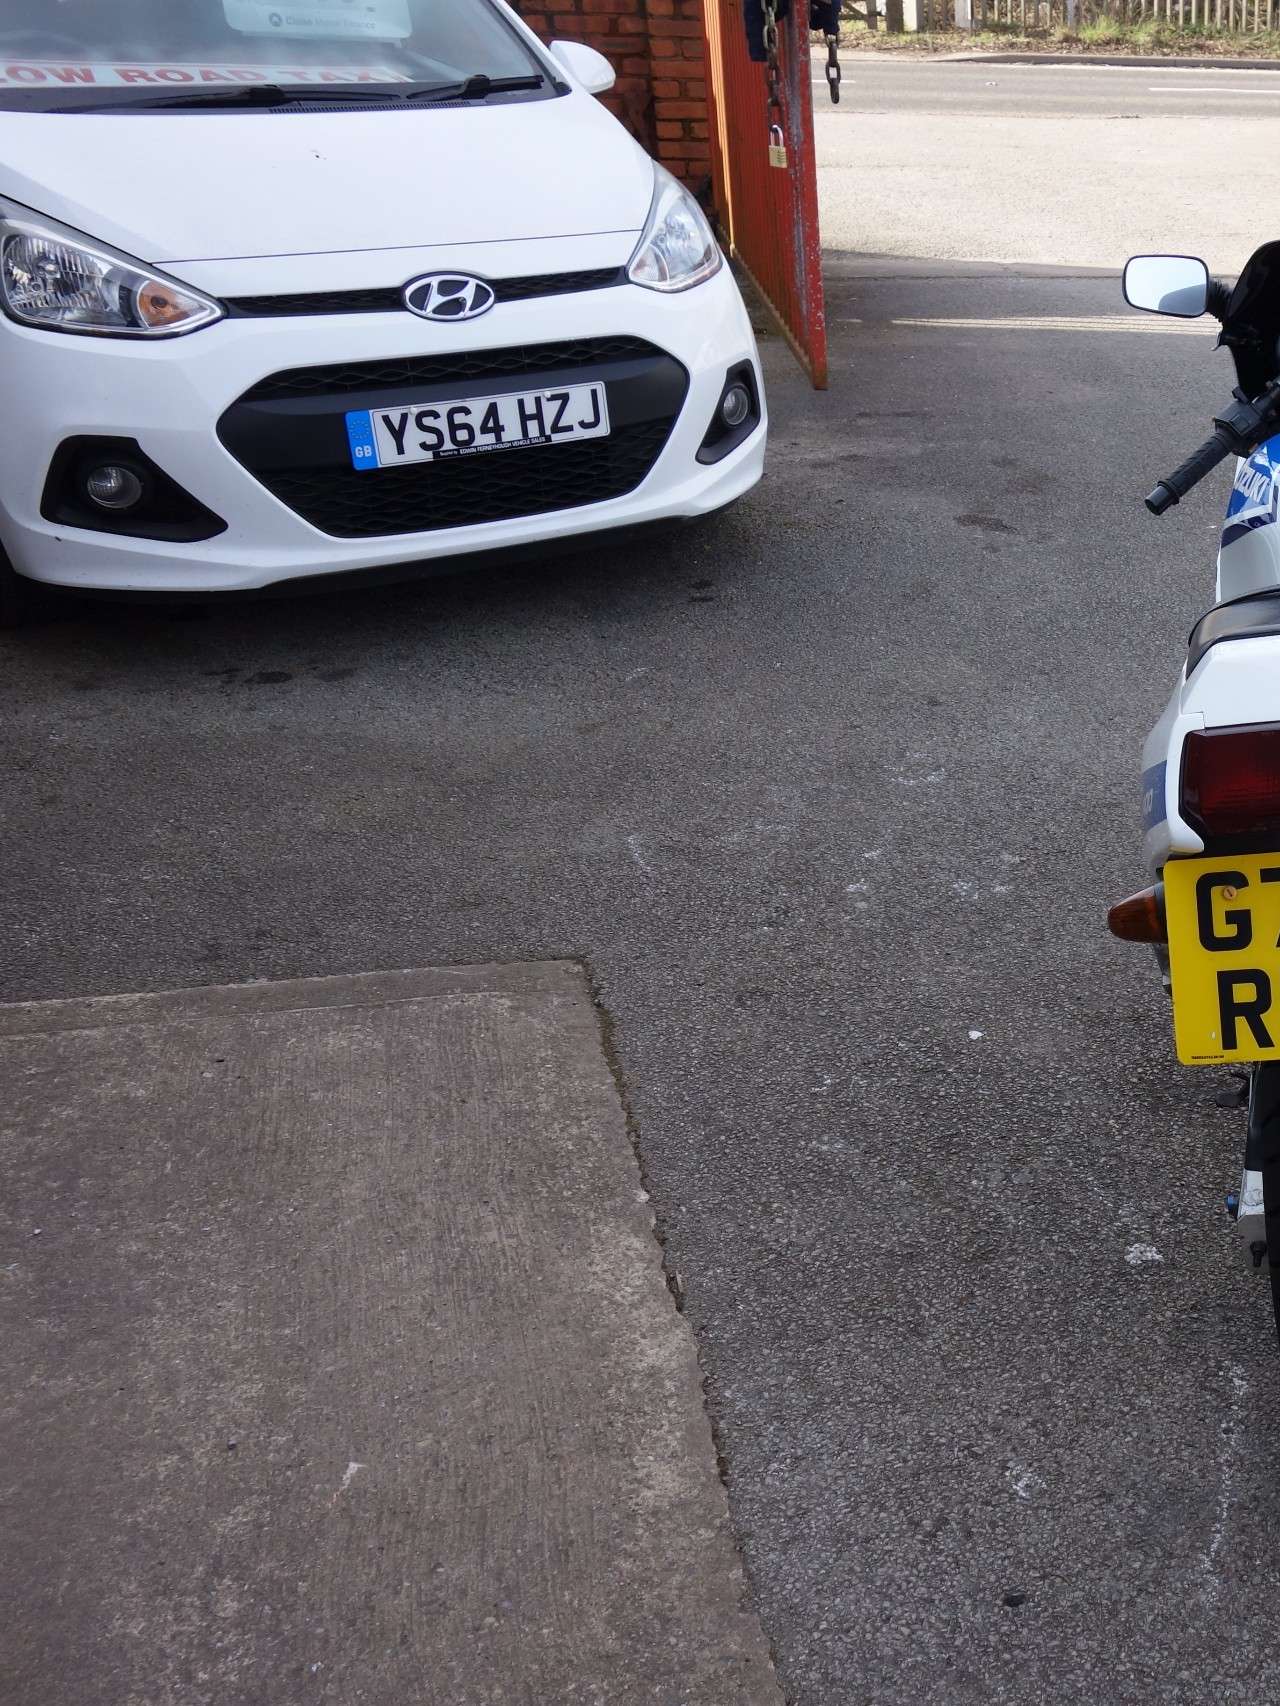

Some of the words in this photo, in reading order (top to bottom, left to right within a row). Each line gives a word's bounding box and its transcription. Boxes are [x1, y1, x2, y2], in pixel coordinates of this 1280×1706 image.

[0, 66, 96, 83] OW
[114, 69, 267, 82] ROAD
[381, 402, 505, 456] YS64
[517, 388, 601, 438] HZJ
[355, 447, 372, 458] GB
[460, 447, 477, 455] EDWIN
[512, 439, 530, 447] VEHICLE
[531, 436, 546, 444] SALES
